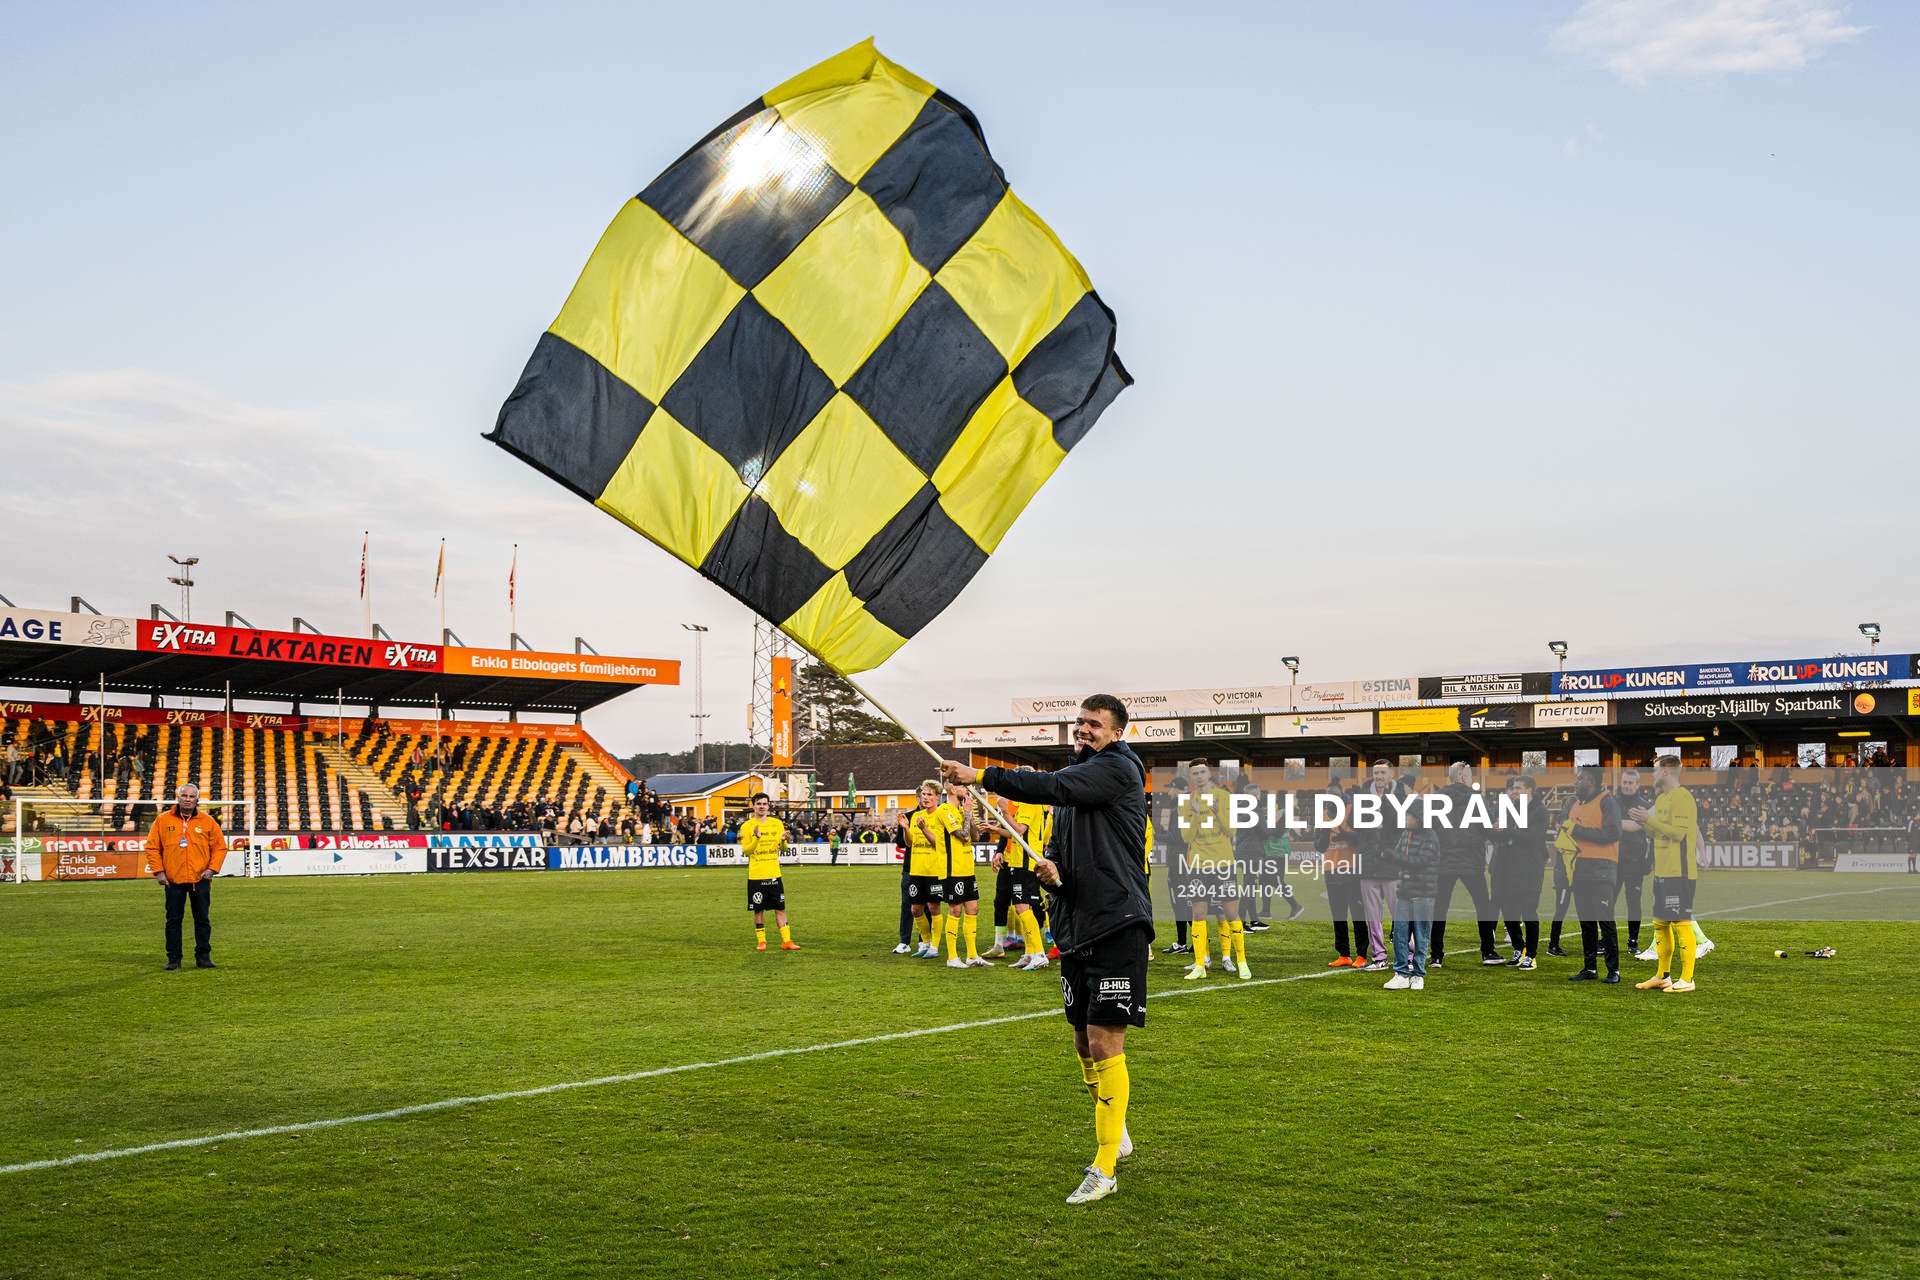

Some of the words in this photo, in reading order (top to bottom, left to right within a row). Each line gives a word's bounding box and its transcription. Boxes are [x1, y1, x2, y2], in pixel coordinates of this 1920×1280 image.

[0, 617, 62, 641] AGE
[151, 623, 217, 650] EXTRA
[229, 631, 373, 665] LÄKTAREN
[384, 643, 437, 668] EXTRA
[471, 655, 508, 669] Enkla
[511, 657, 577, 674] Elbolagets
[579, 661, 657, 677] familjehörna
[1373, 679, 1412, 692] STENA
[1464, 674, 1499, 683] ANDERS
[1444, 684, 1458, 693] BIL
[1469, 683, 1505, 692] MASKIN
[1507, 682, 1520, 690] AB
[1133, 695, 1167, 704] VICTORIA
[1226, 691, 1263, 700] VICTORIA
[0, 701, 33, 718] XTRA
[1045, 700, 1077, 708] VICTORIA
[1538, 705, 1605, 717] meritum
[1644, 699, 1770, 717] Sölvesborg-Mjällby
[1775, 696, 1842, 716] Sparbank
[166, 710, 206, 725] EXTRA
[246, 714, 283, 728] EXTRA
[1470, 717, 1485, 728] EY
[1144, 725, 1176, 737] Crowe
[431, 847, 546, 869] TEXSTAR
[559, 845, 699, 869] MALMBERGS
[1696, 845, 1794, 867] UNIBET
[56, 864, 117, 876] Elbolaget
[1099, 980, 1131, 991] LB-HUS
